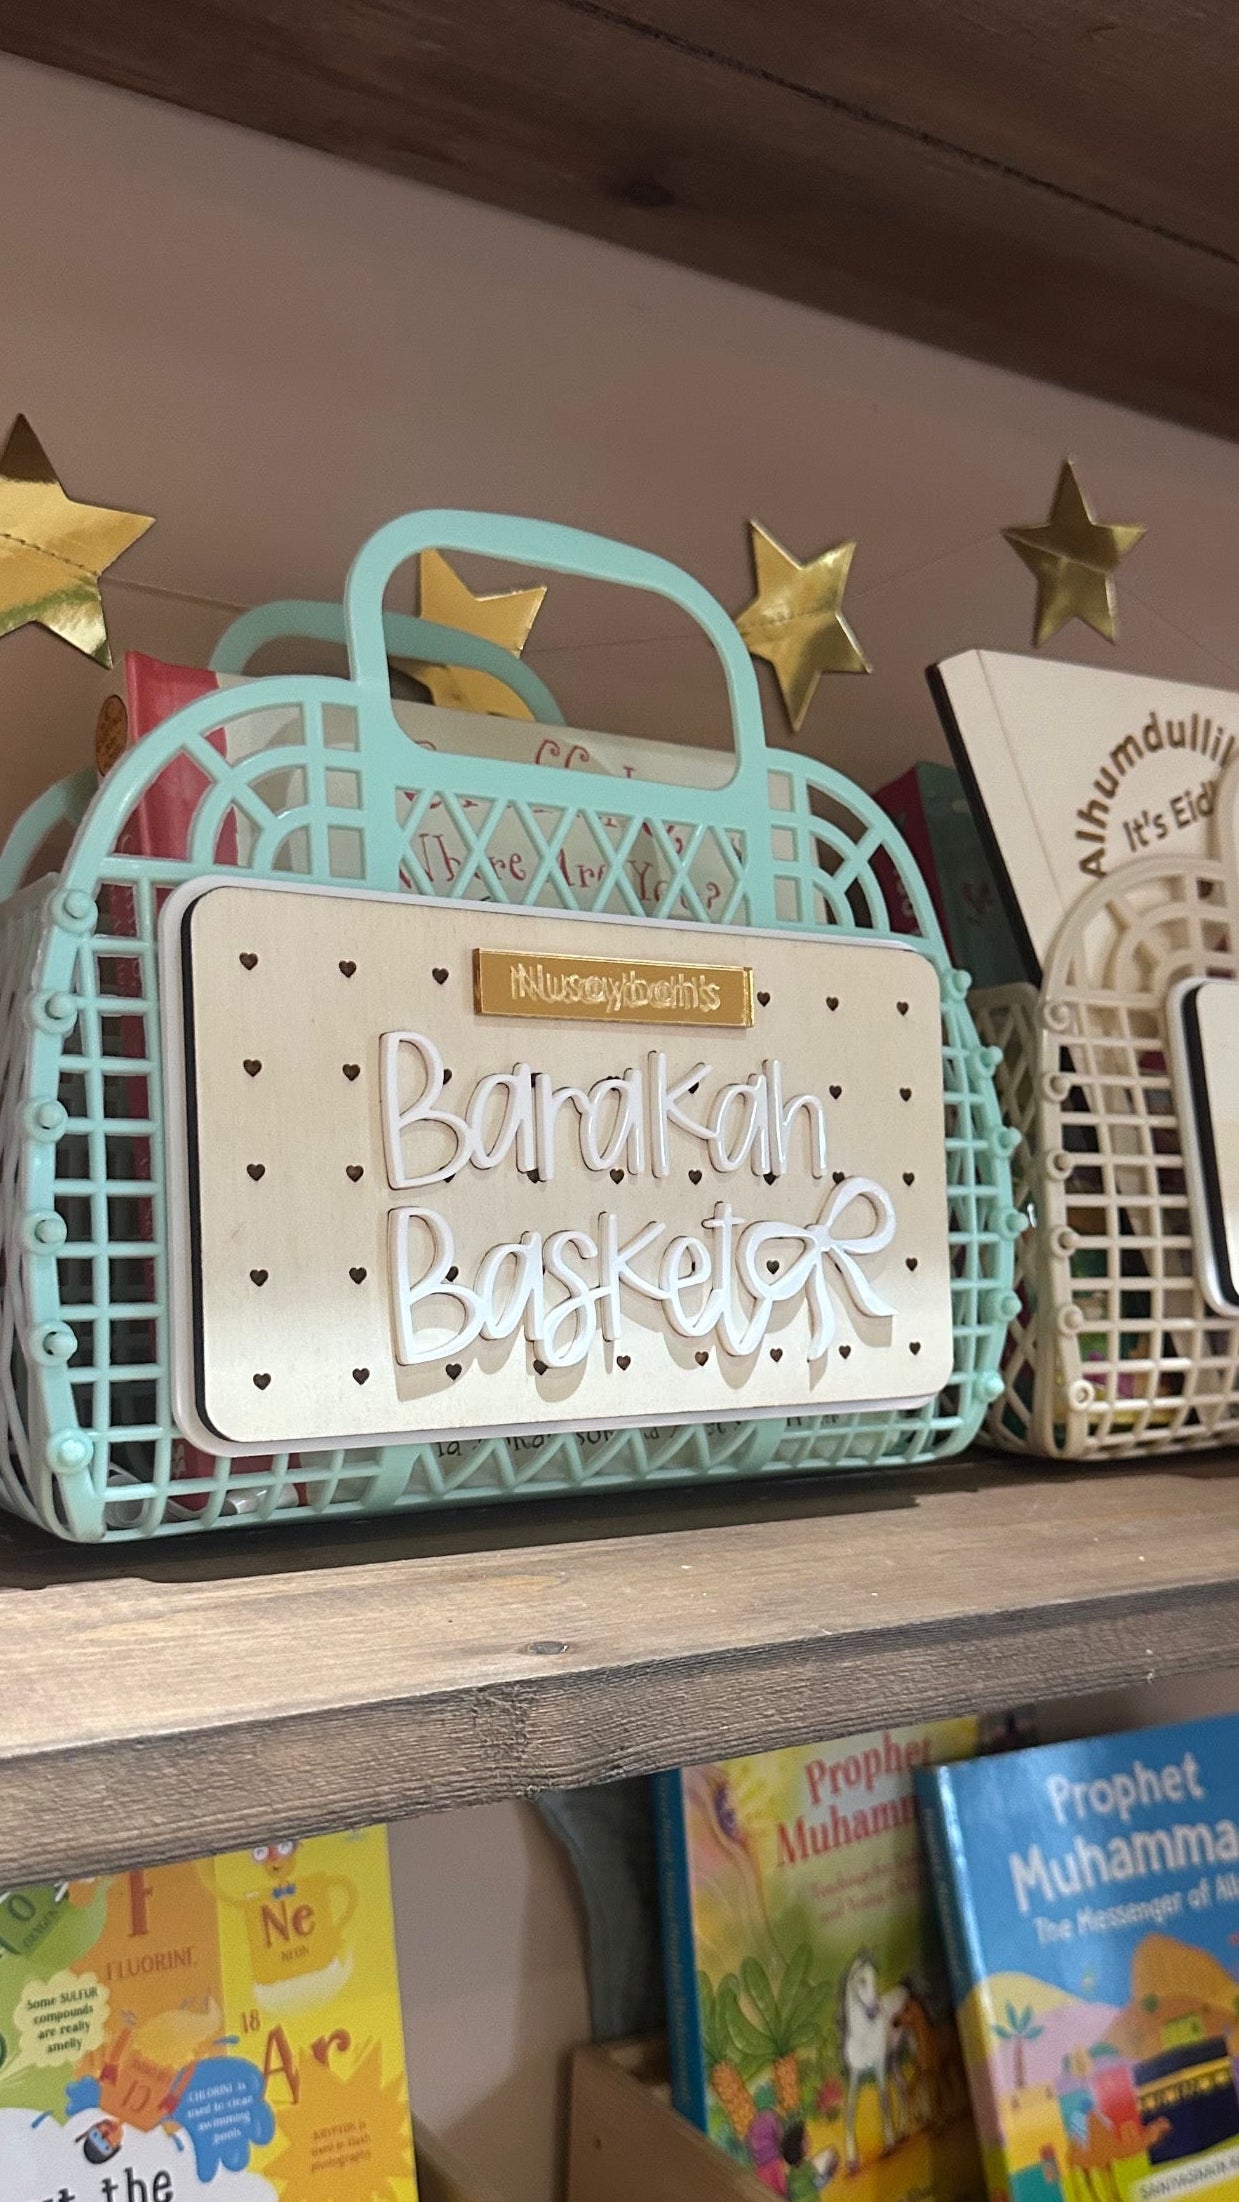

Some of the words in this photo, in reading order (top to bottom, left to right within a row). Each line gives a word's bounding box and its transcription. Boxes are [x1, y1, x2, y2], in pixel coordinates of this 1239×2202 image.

[1123, 809, 1167, 852] It's
[379, 1030, 828, 1190] Barakah
[387, 1201, 775, 1368] Basket
[804, 1729, 932, 1806] Prophet
[1046, 1752, 1205, 1827] Prophet
[260, 1899, 316, 1949] Ne
[1033, 1916, 1073, 1946] The
[1076, 1892, 1184, 1935] Messenger
[1187, 1878, 1212, 1910] of
[106, 1945, 196, 1981] FLUORINE
[26, 1996, 57, 2011] Some
[59, 1986, 98, 2003] SULFUR
[33, 2003, 94, 2024] compounds
[38, 2027, 56, 2040] are
[60, 2020, 91, 2035] really
[240, 2009, 260, 2034] 18
[47, 2037, 82, 2054] smelly
[262, 2022, 351, 2106] Ar
[101, 2167, 174, 2202] the
